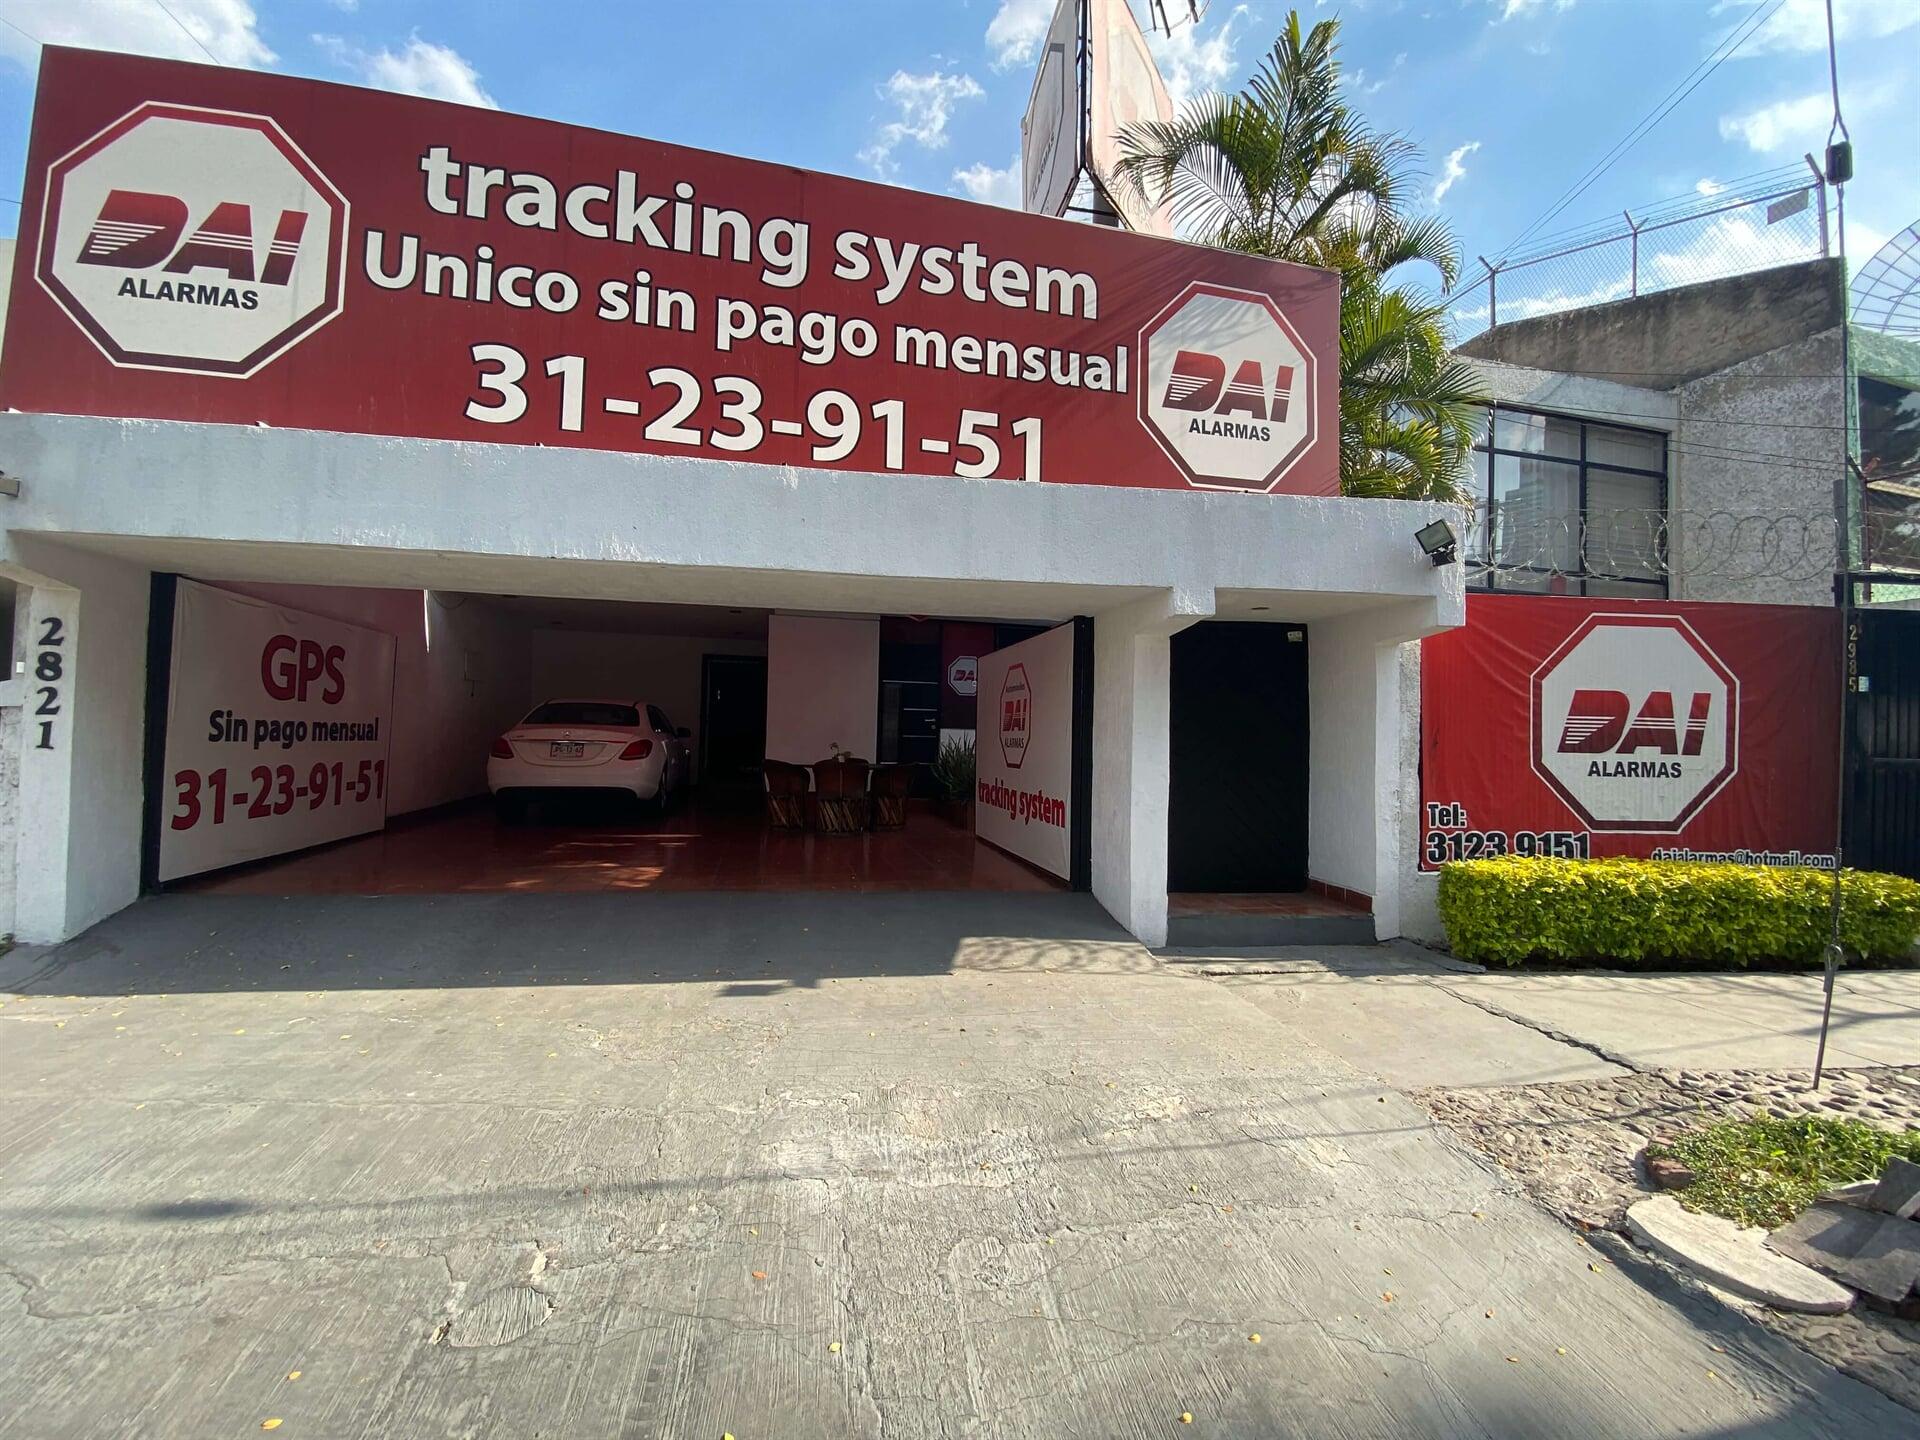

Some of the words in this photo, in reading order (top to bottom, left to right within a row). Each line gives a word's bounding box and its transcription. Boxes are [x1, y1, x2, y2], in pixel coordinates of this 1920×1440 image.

[77, 189, 308, 286] DAI
[419, 144, 809, 289] tracking
[833, 227, 1099, 321] system
[117, 276, 260, 311] ALARMAS
[364, 229, 580, 314] Unico
[597, 269, 696, 333] sin
[714, 296, 878, 366] pago
[894, 322, 1130, 394] mensual
[1161, 350, 1295, 423] DAI
[463, 342, 1043, 483] 31-23-91-51
[1188, 417, 1271, 442] ALARMAS
[34, 616, 65, 751] 2821
[261, 633, 347, 705] GPS
[953, 669, 976, 682] DA
[207, 709, 249, 744] Sin
[253, 717, 307, 750] pago
[311, 717, 380, 742] mensual
[1002, 698, 1027, 732] DAI
[1557, 689, 1712, 757] DAI
[1004, 736, 1025, 749] ALARMAS
[170, 759, 386, 831] 31-23-91-51
[1587, 760, 1682, 779] ALARMAS
[978, 777, 1018, 820] tracking
[1019, 790, 1066, 828] system
[1426, 802, 1467, 829] Tel:
[1426, 831, 1508, 864] 3123
[1514, 831, 1591, 861] 9151
